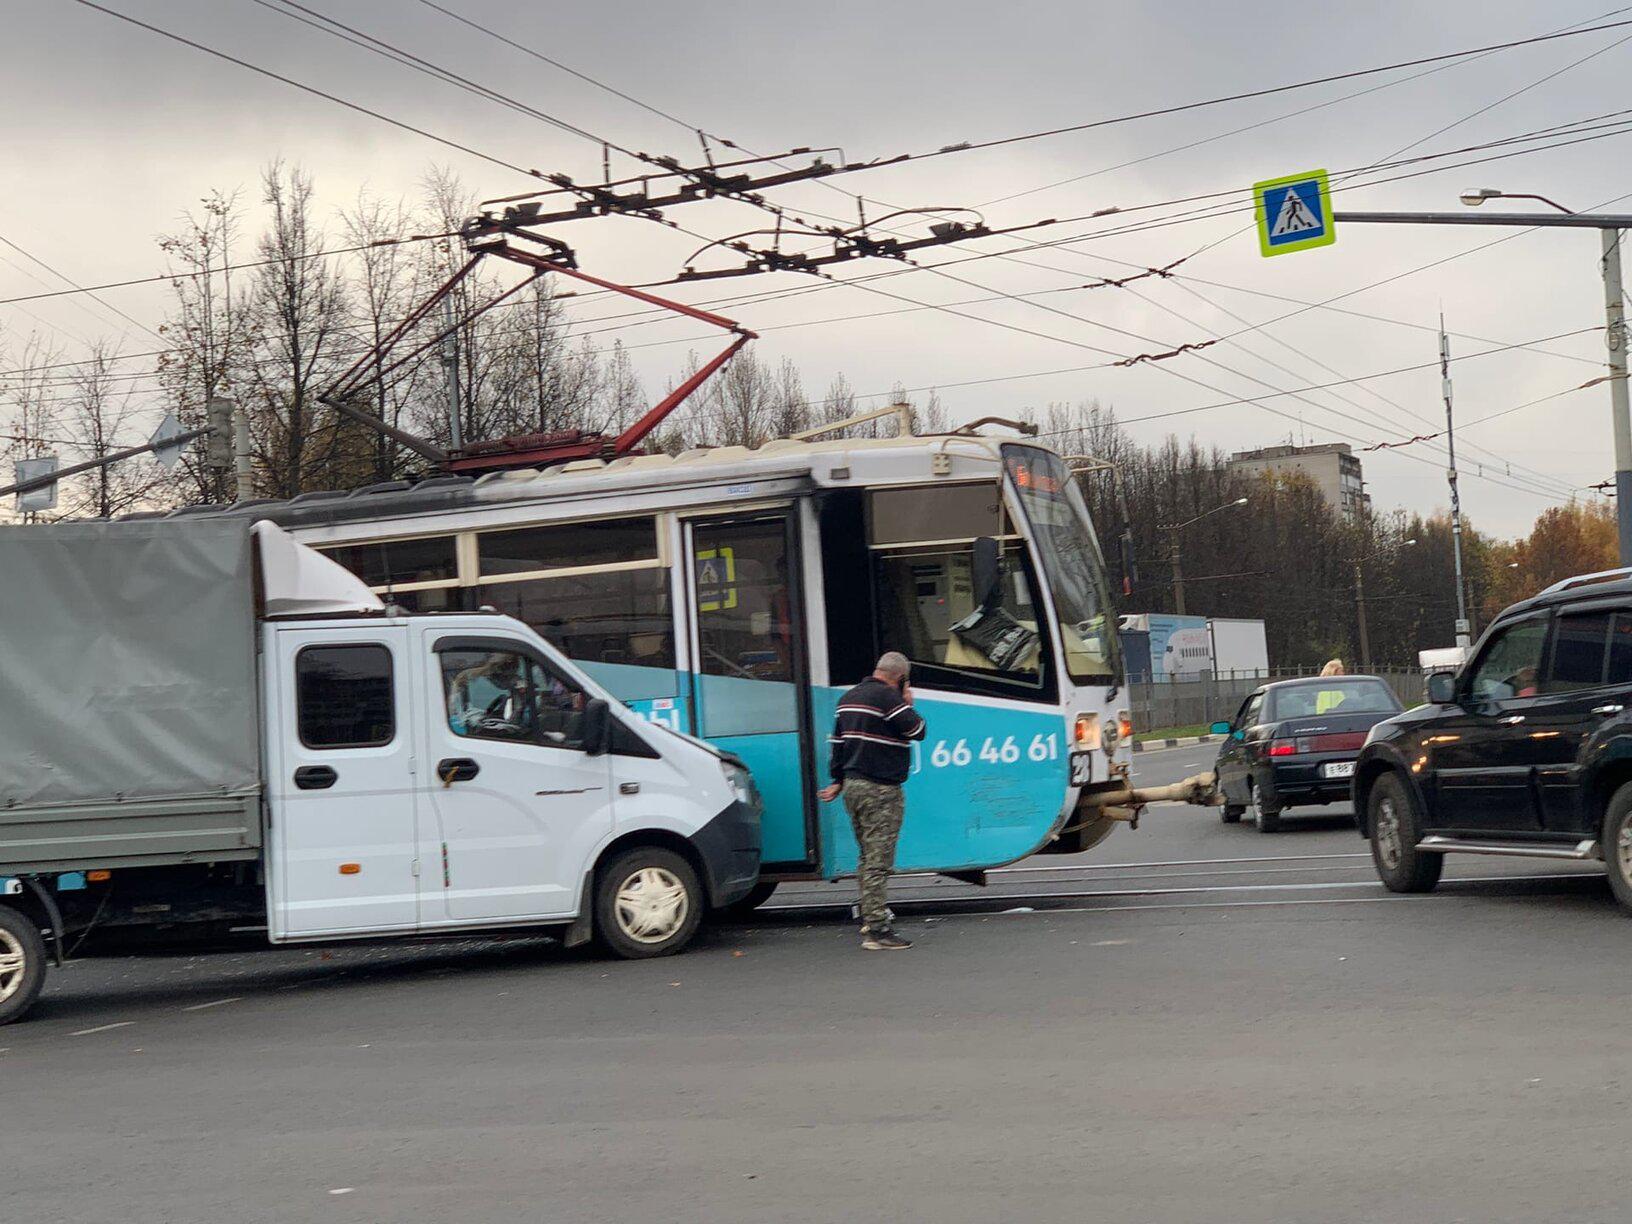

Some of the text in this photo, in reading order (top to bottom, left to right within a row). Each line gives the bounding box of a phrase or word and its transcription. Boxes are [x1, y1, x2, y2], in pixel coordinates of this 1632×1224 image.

[930, 732, 1058, 767] 66 46 61
